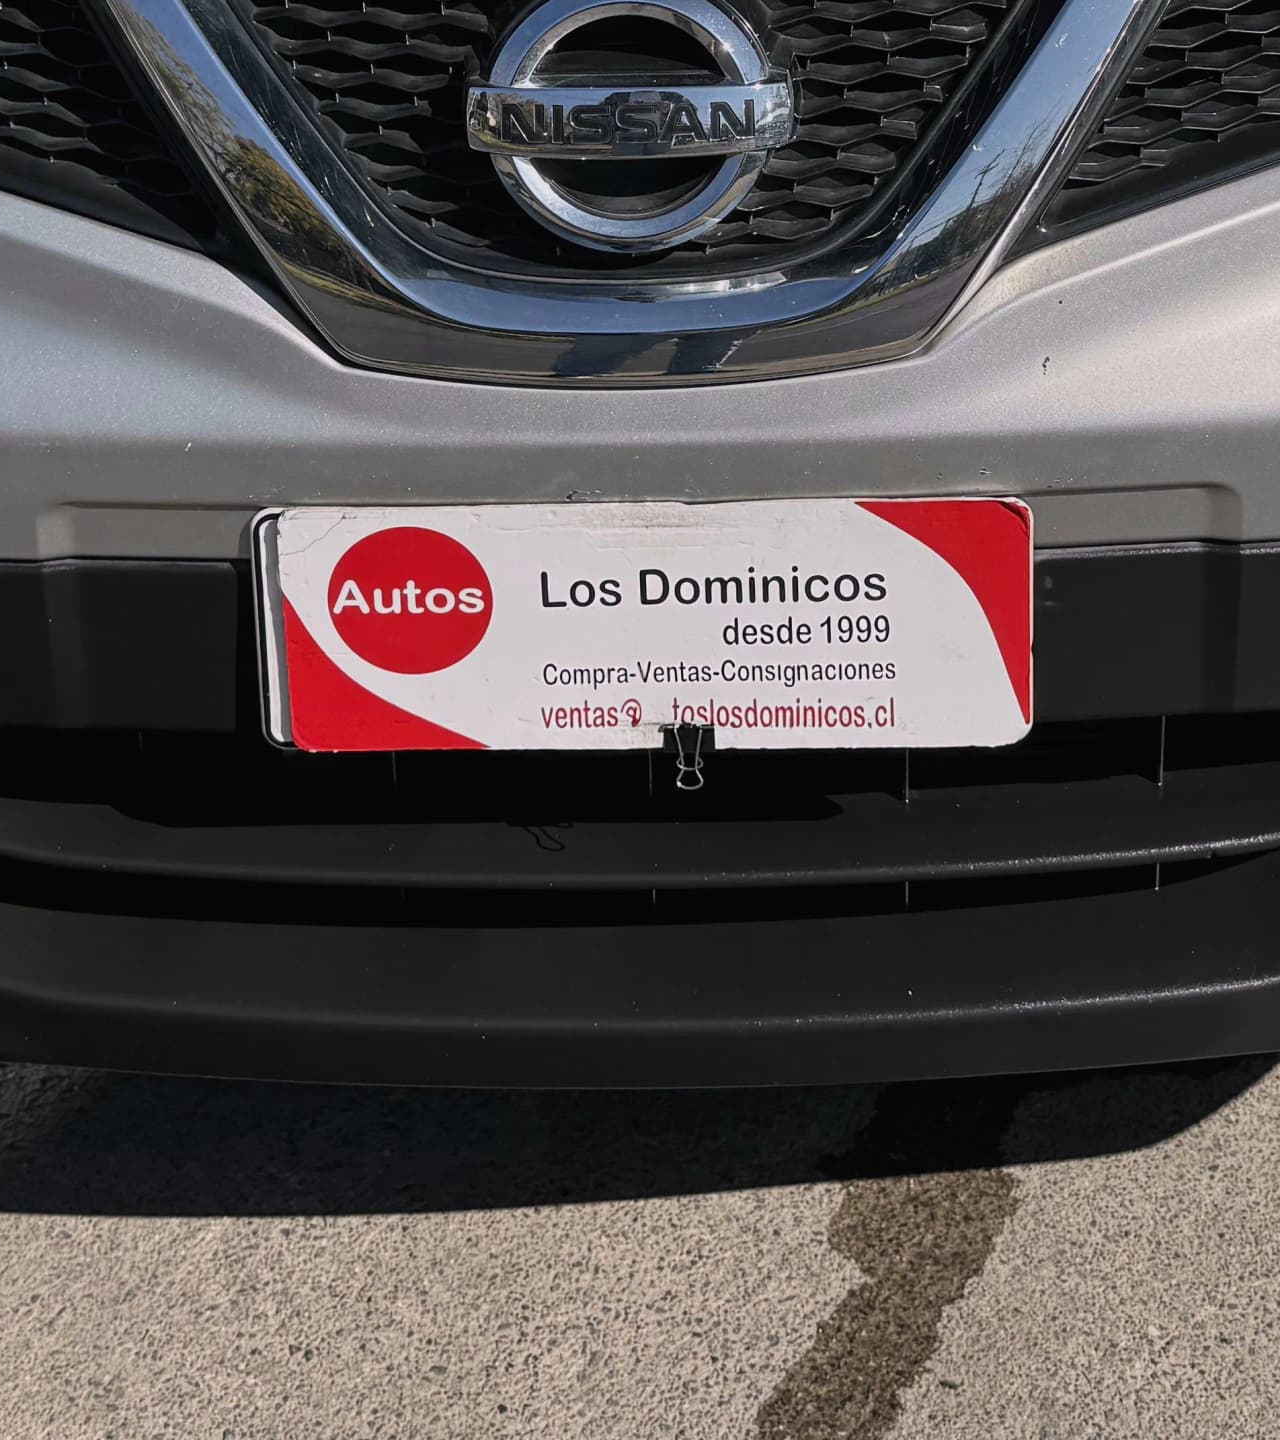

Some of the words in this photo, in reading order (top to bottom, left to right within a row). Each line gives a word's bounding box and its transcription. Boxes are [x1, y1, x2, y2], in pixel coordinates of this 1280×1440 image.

[500, 98, 756, 144] NISSAN
[333, 579, 486, 615] Autos
[540, 571, 621, 609] Los
[638, 565, 887, 606] Dominicos
[723, 616, 813, 646] desde
[818, 614, 891, 645] 1999
[543, 659, 896, 690] Compra-Ventas-Consignaciones
